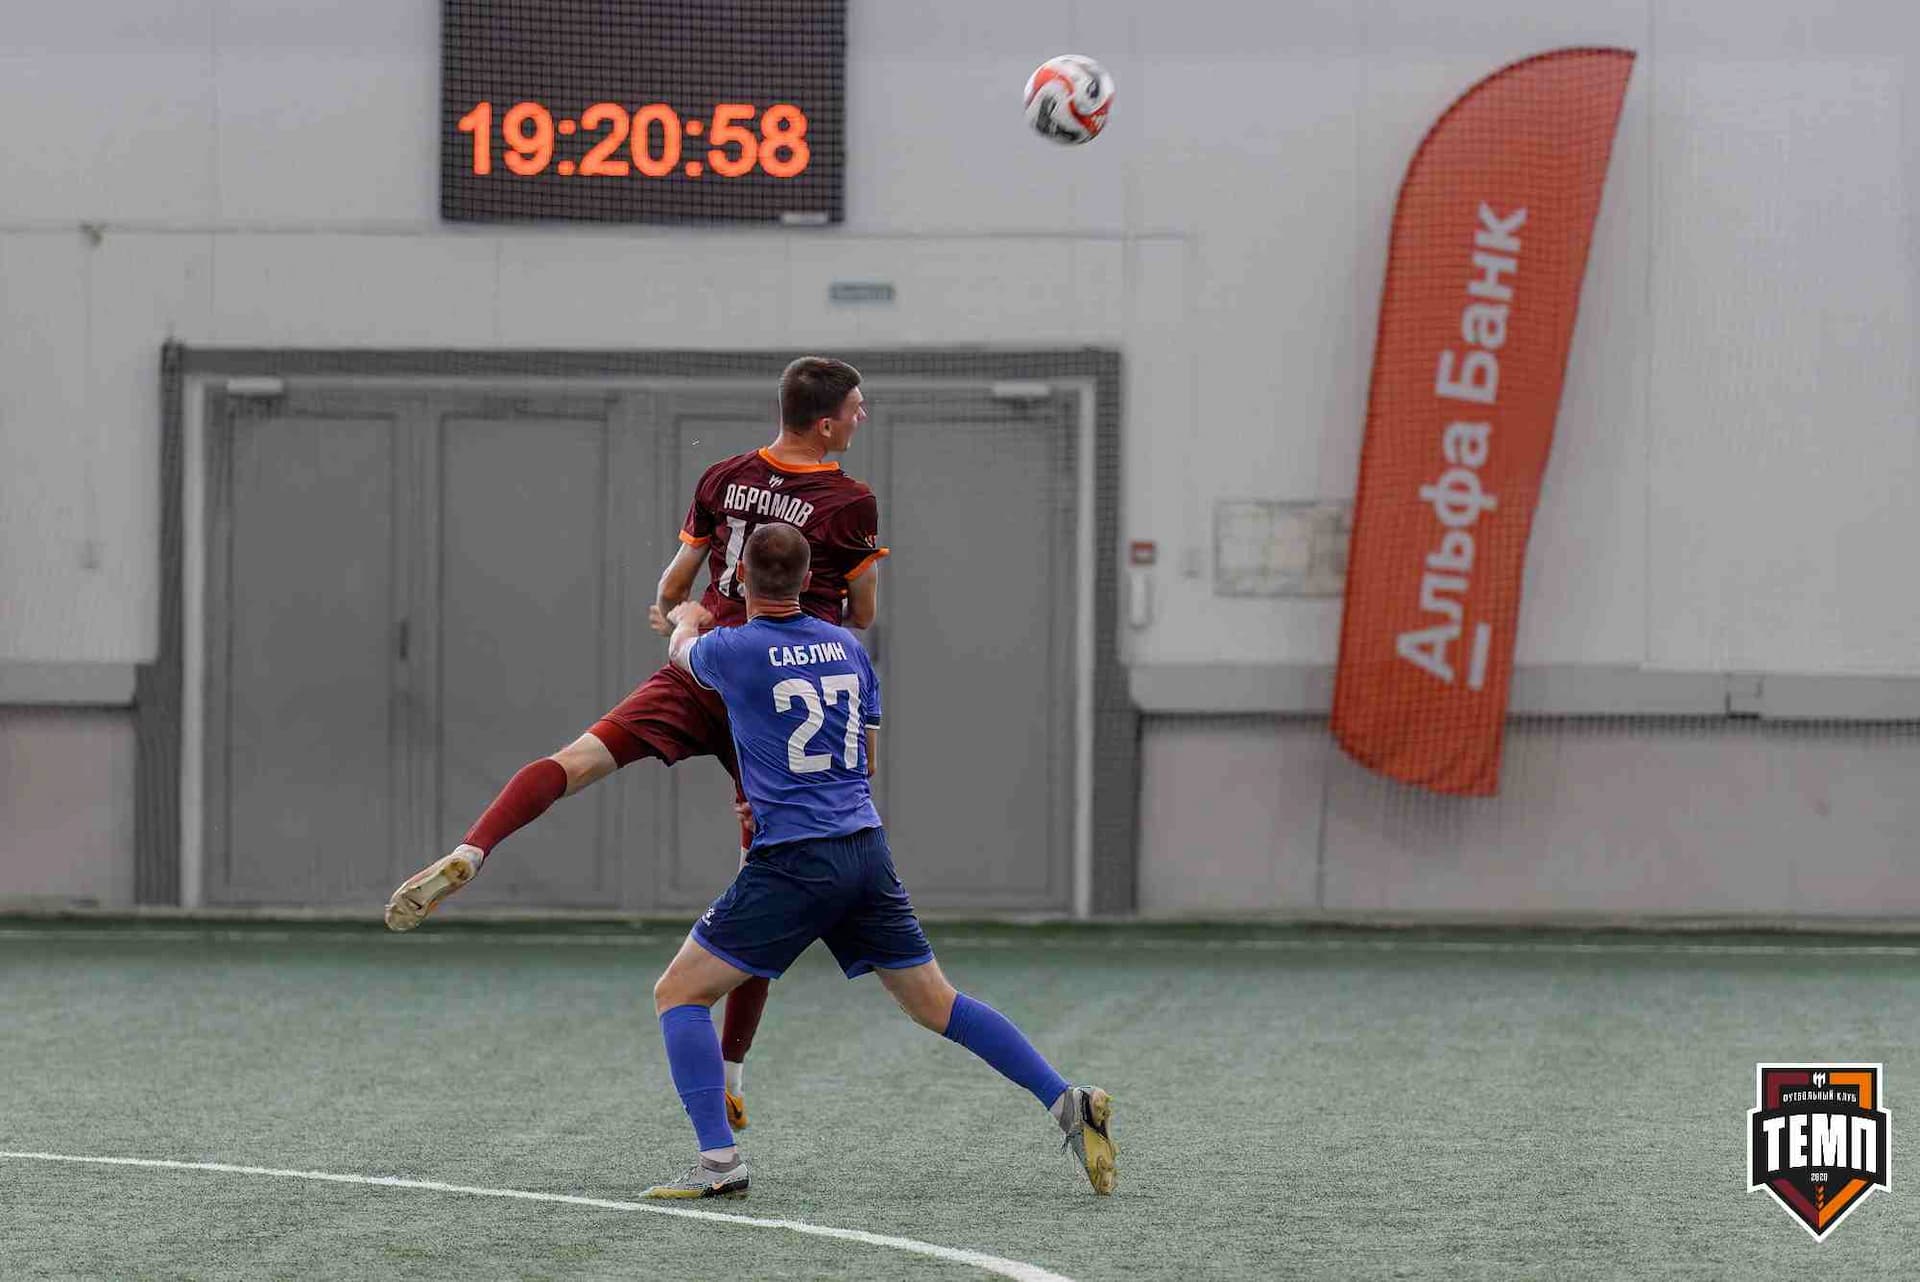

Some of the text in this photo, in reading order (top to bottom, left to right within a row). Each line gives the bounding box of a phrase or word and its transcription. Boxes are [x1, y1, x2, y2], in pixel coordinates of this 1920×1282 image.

[457, 101, 811, 178] 19:20:58
[1396, 200, 1528, 684] Альфа Банк
[724, 483, 814, 528] АБРАМОВ
[768, 642, 847, 667] САБЛИН
[772, 673, 861, 773] 27
